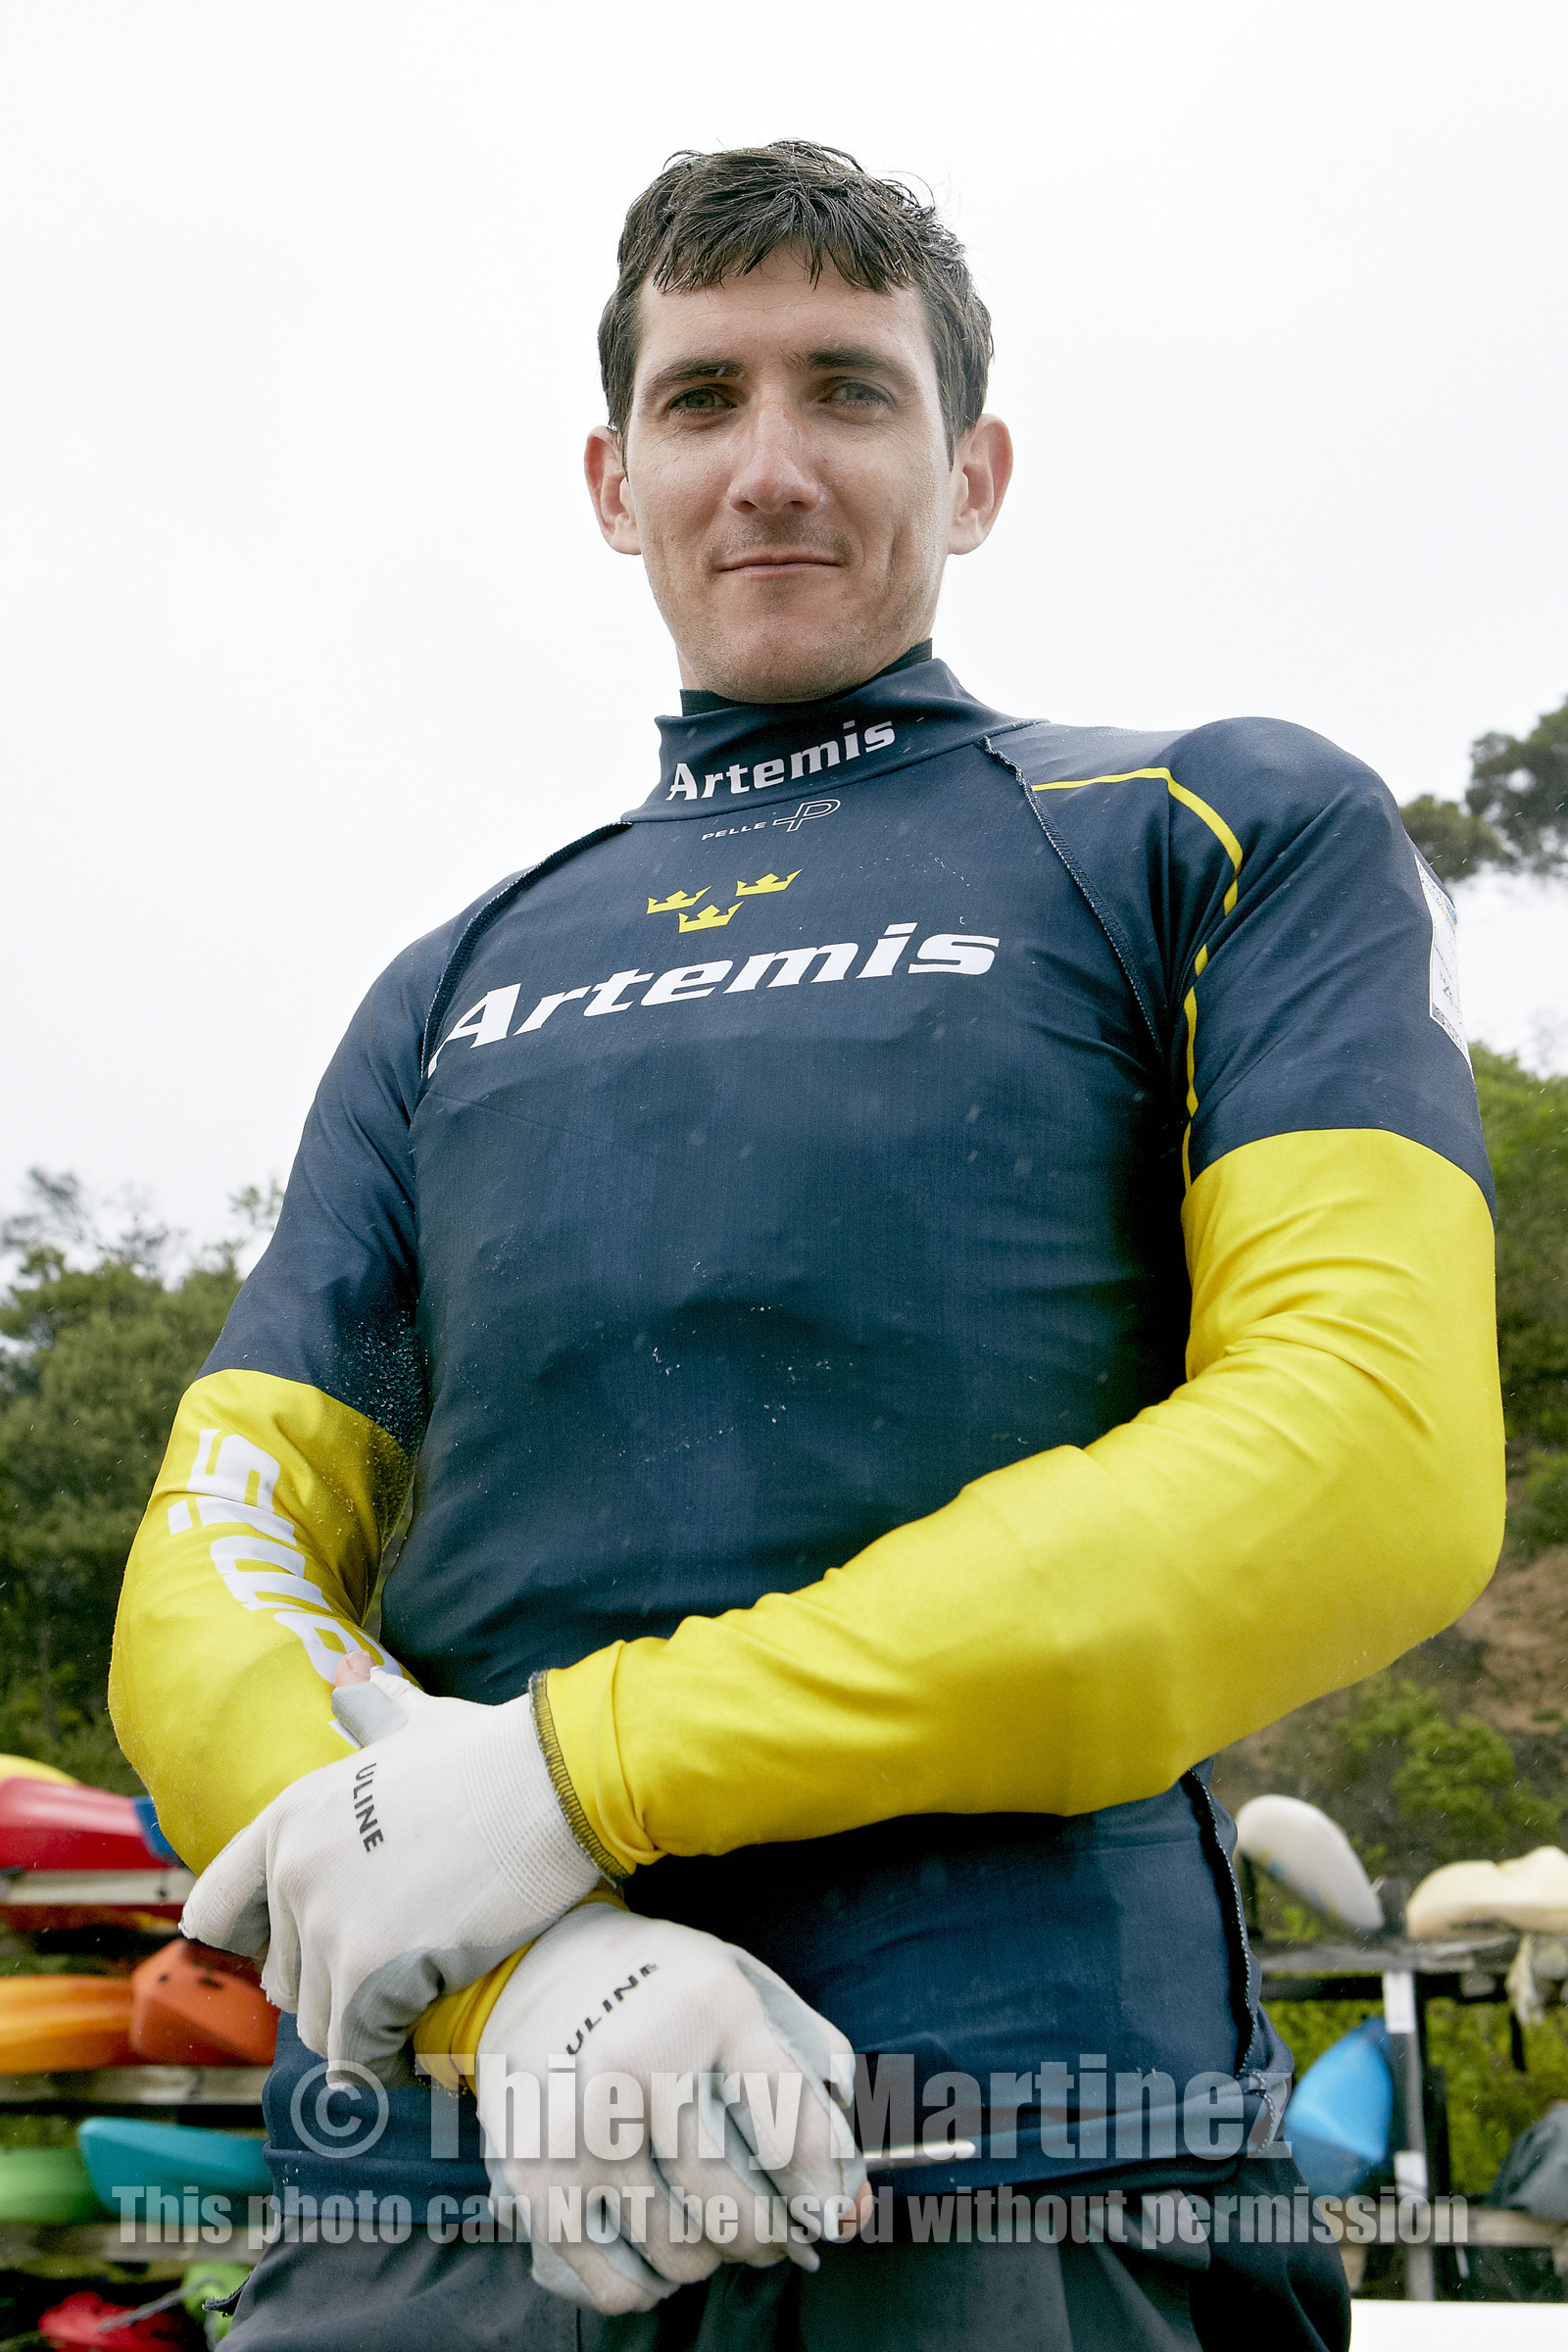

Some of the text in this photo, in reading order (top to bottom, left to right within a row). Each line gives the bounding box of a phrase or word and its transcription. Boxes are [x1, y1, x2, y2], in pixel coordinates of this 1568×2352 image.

[665, 719, 896, 801] Artemis
[701, 821, 768, 841] PELLE
[427, 922, 1000, 1079] Artemis
[353, 1762, 384, 1852] ULINE
[565, 1963, 659, 2055] ULINE
